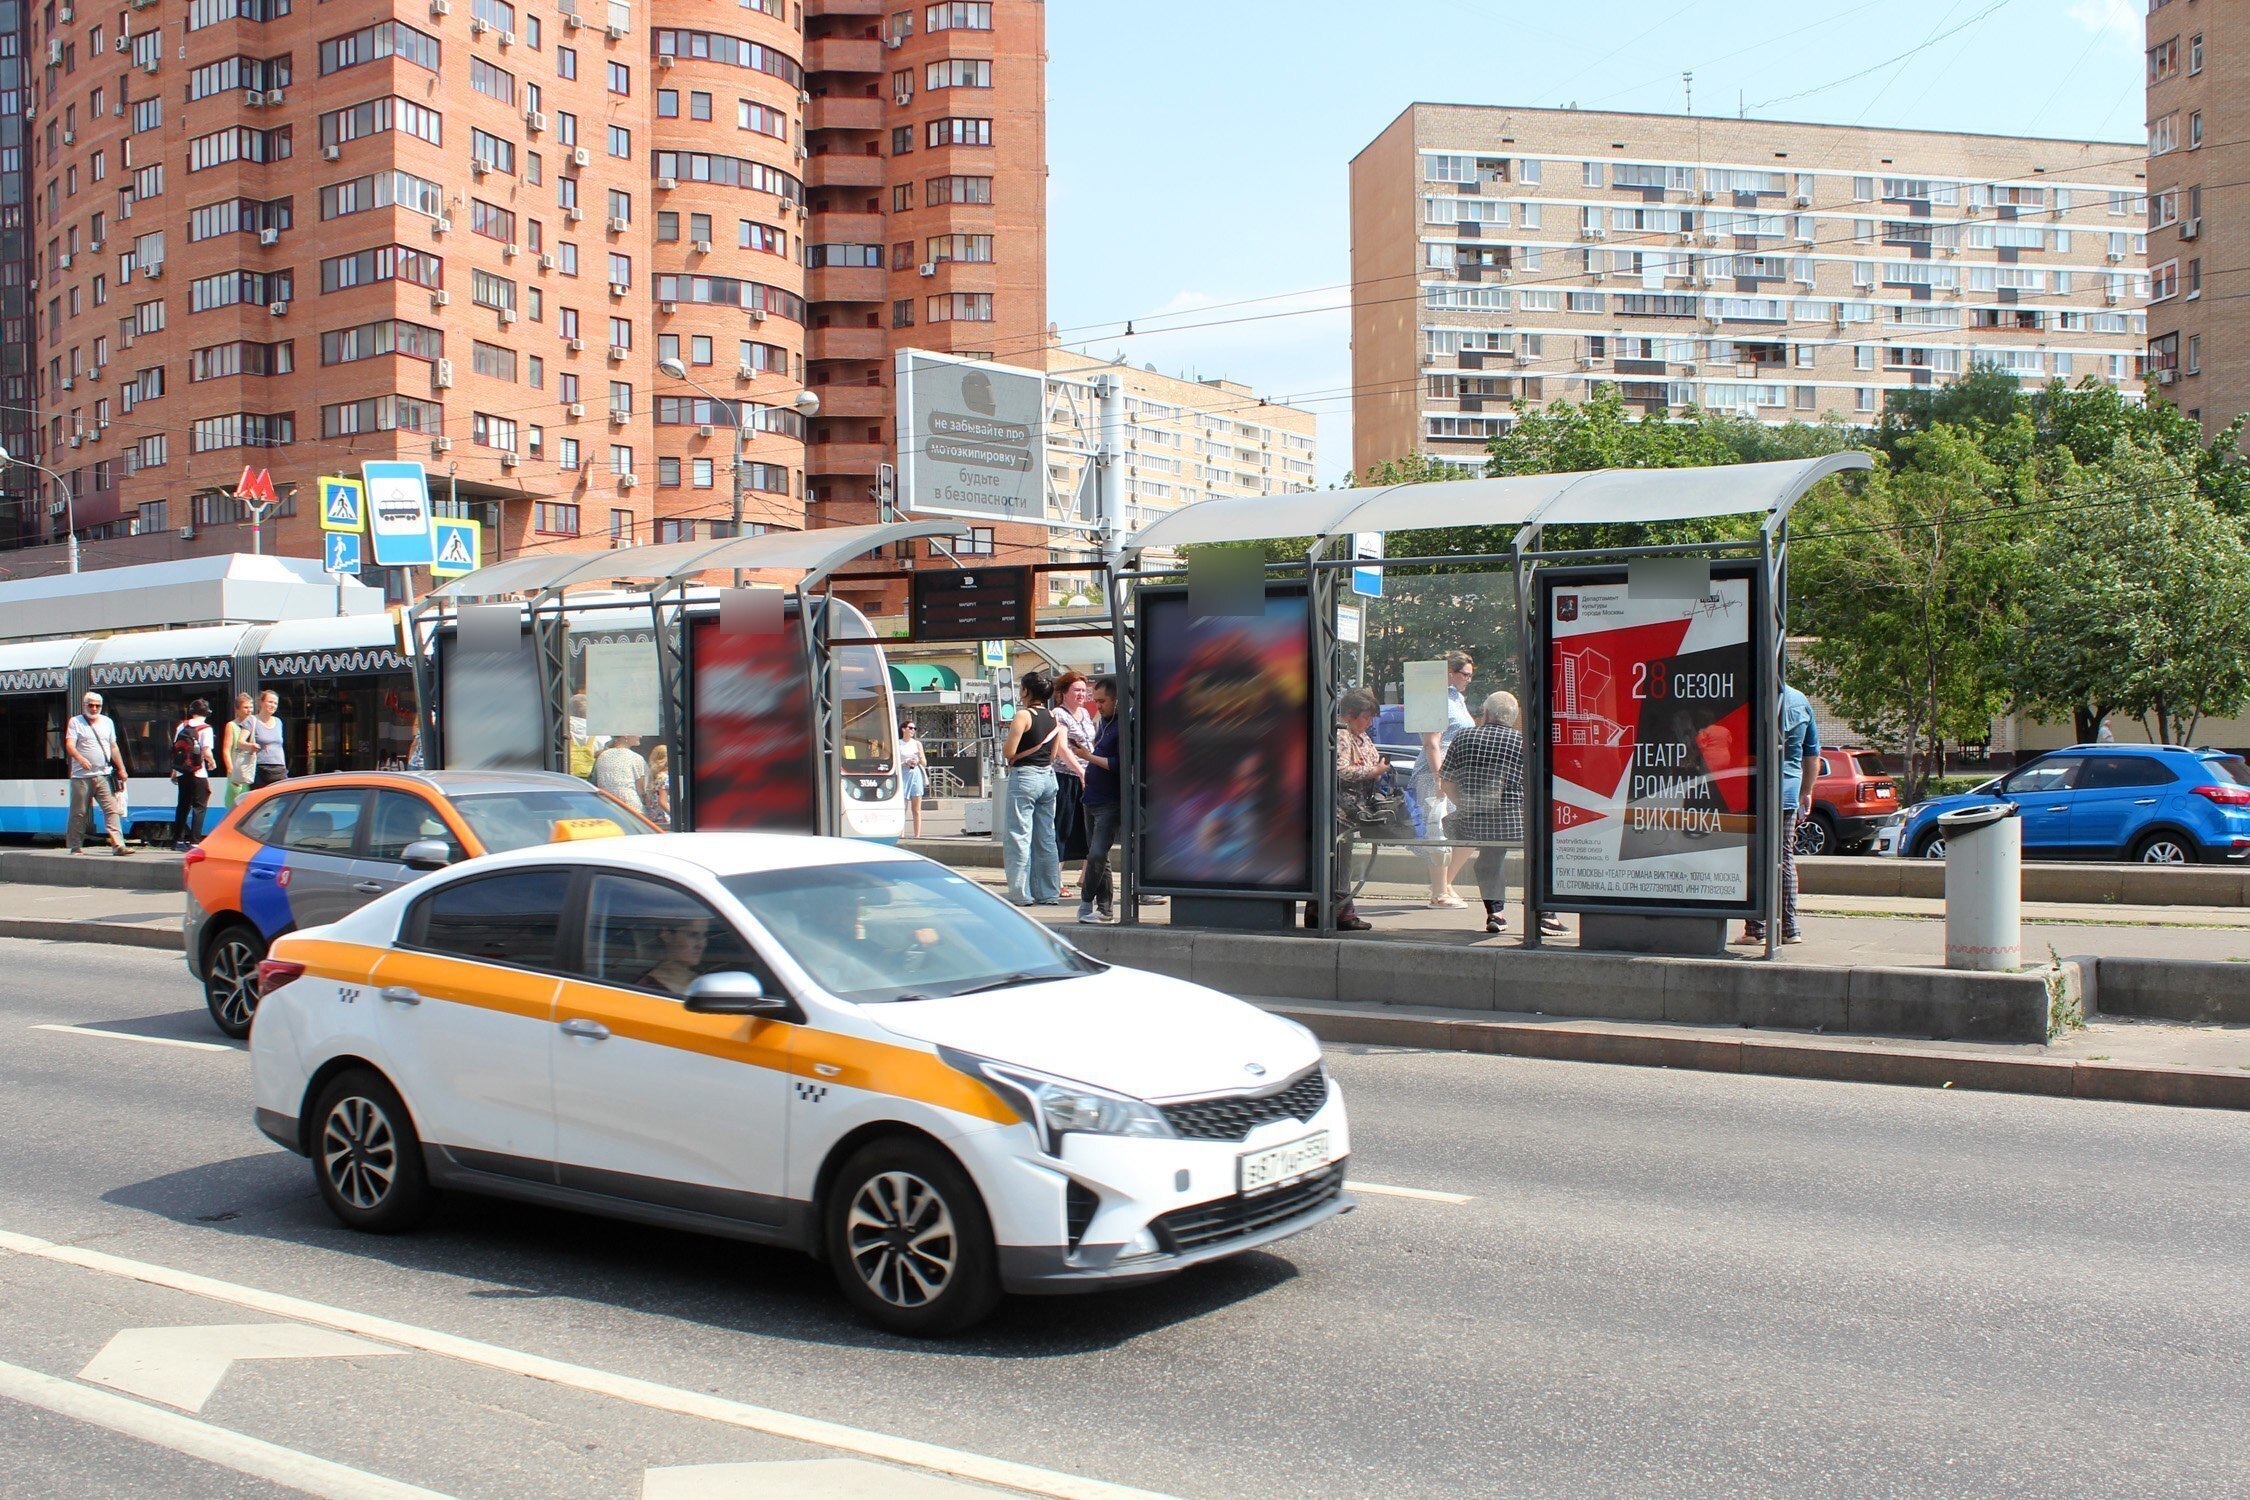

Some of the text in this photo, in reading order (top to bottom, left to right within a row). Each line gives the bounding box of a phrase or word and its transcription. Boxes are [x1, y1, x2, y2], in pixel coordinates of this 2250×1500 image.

[935, 418, 1025, 442] не забывайте про
[931, 443, 1017, 467] мотоэкипировку
[959, 468, 1000, 487] будьте
[935, 486, 1027, 509] в безопасности
[1632, 661, 1734, 699] 28 СЕЗОН
[1634, 743, 1687, 767] ТЕАТР
[1634, 775, 1711, 800] РОМАНА
[1556, 805, 1579, 825] 18+
[1634, 806, 1722, 832] ВИКТЮКА
[1567, 881, 1606, 891] СТРОМЫНКА,
[1577, 868, 1604, 878] МОСКВЫ
[1627, 869, 1653, 880] РОМАНА
